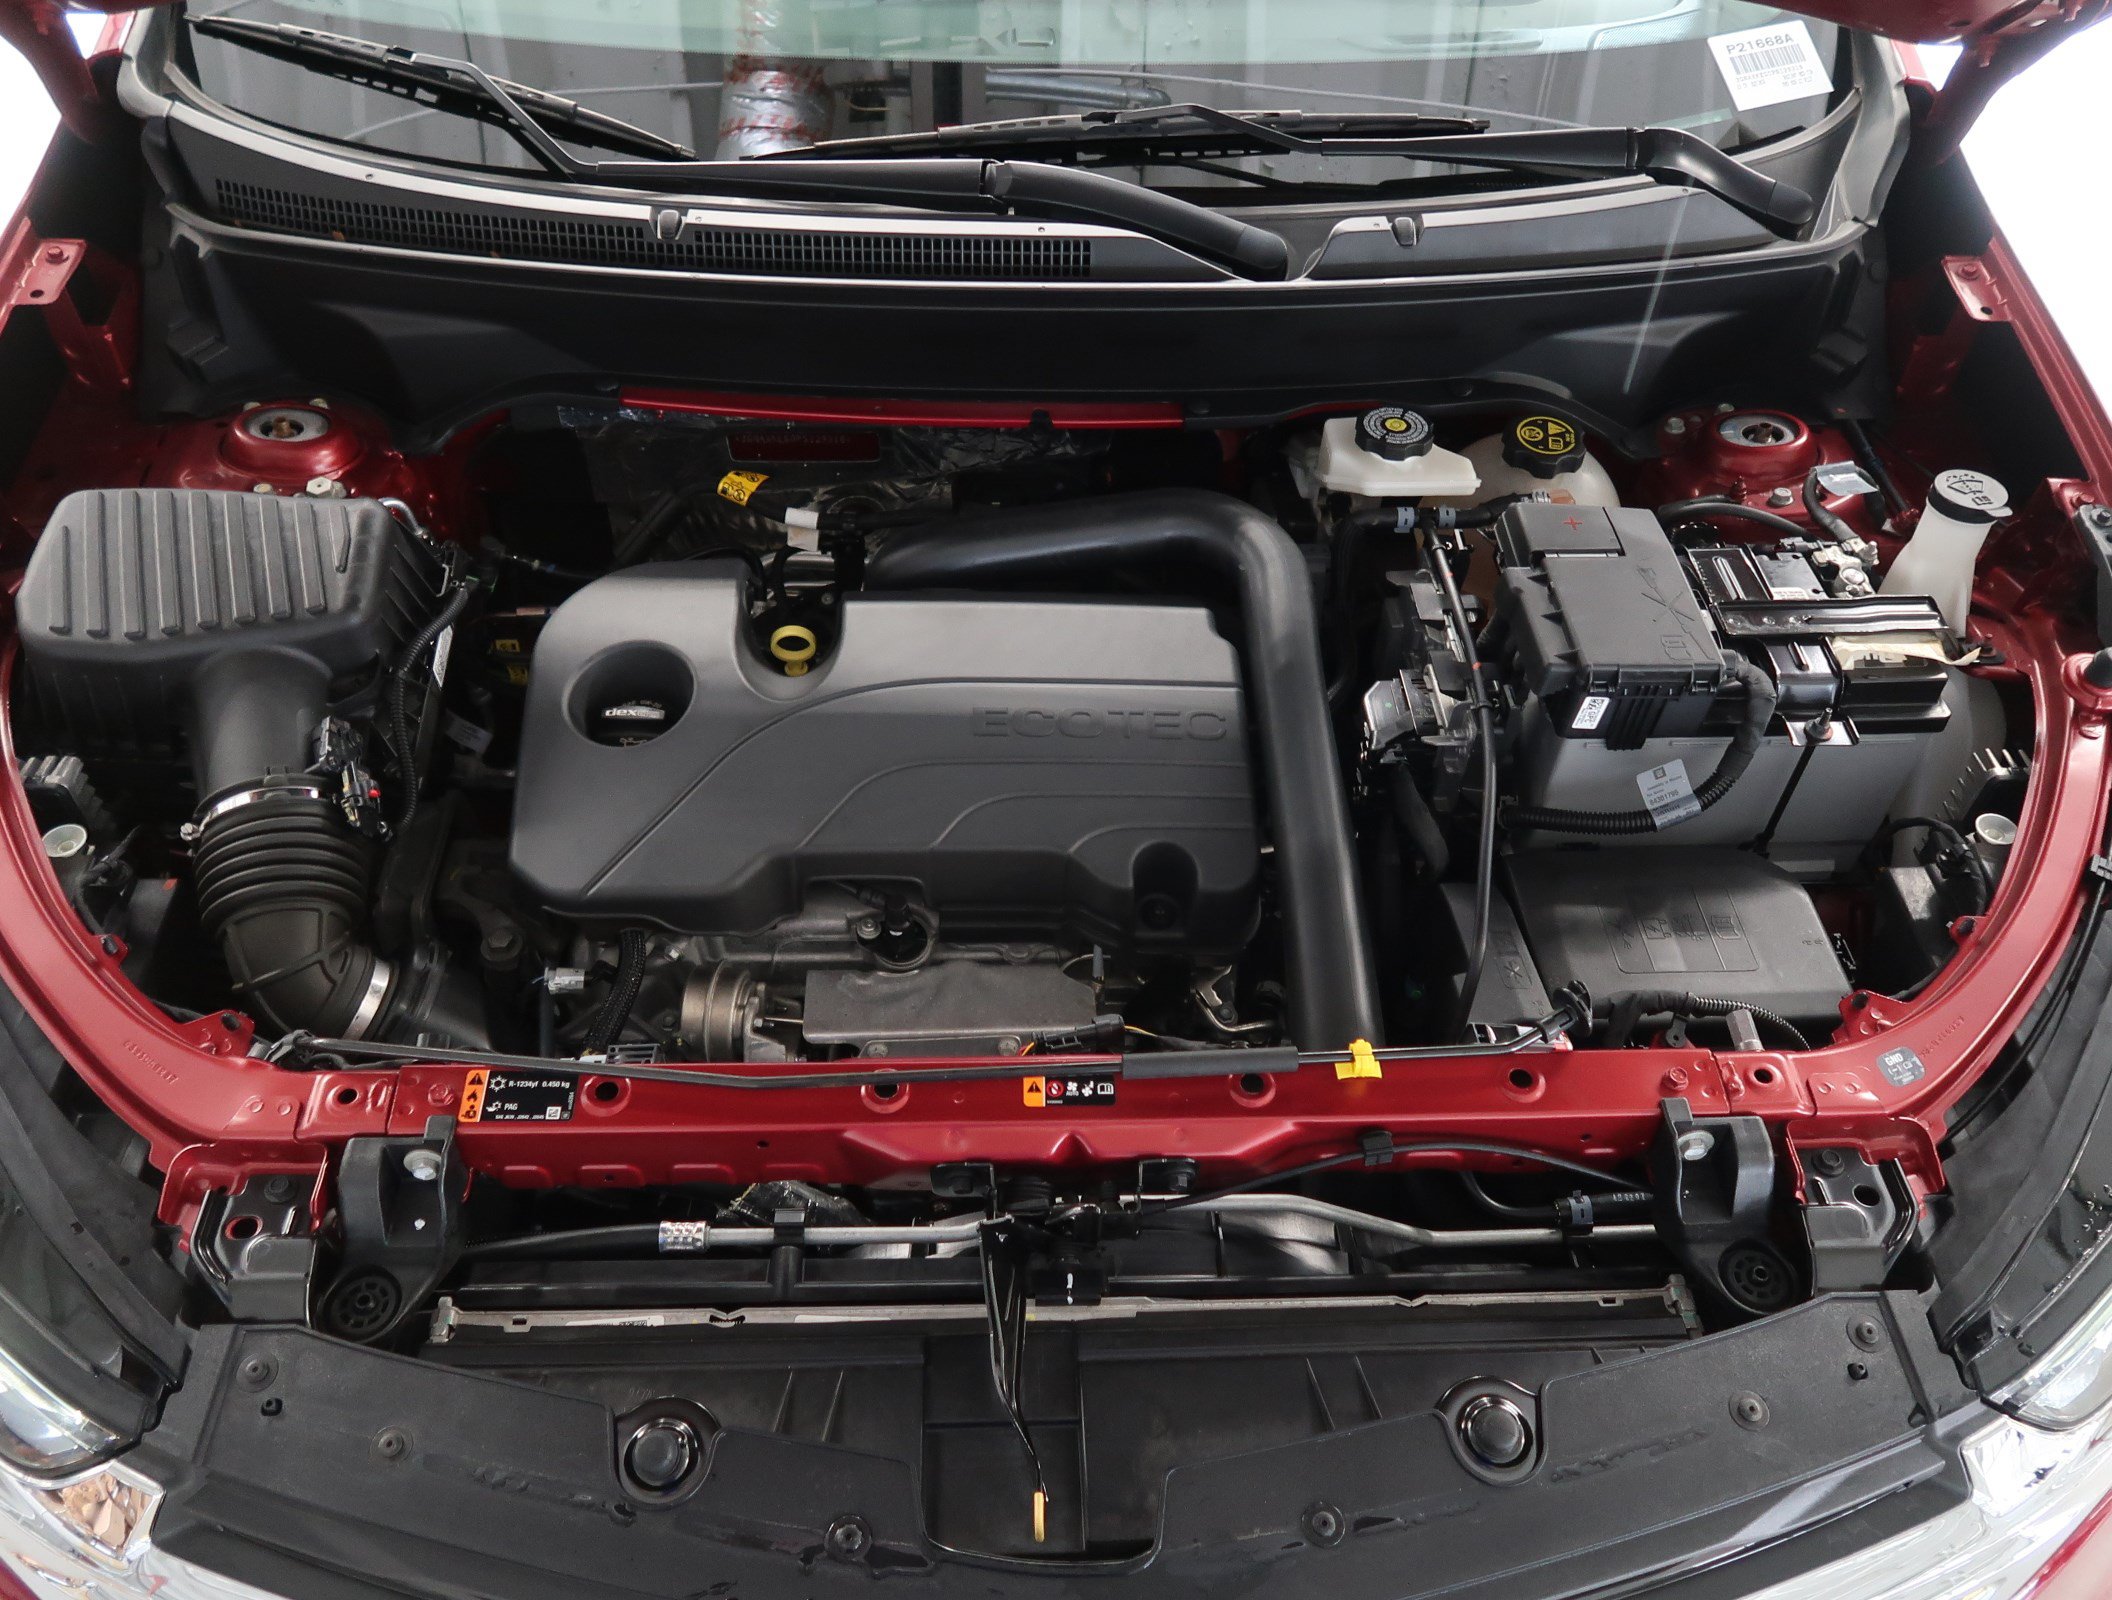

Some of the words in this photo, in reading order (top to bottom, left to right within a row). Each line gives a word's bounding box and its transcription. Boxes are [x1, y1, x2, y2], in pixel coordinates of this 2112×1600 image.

[1726, 33, 1794, 55] P21668A
[972, 706, 1227, 741] ECOTEC
[1884, 1053, 1903, 1066] GND
[508, 1081, 538, 1089] R-1234yf
[561, 1081, 570, 1089] kg
[503, 1103, 518, 1111] PAG
